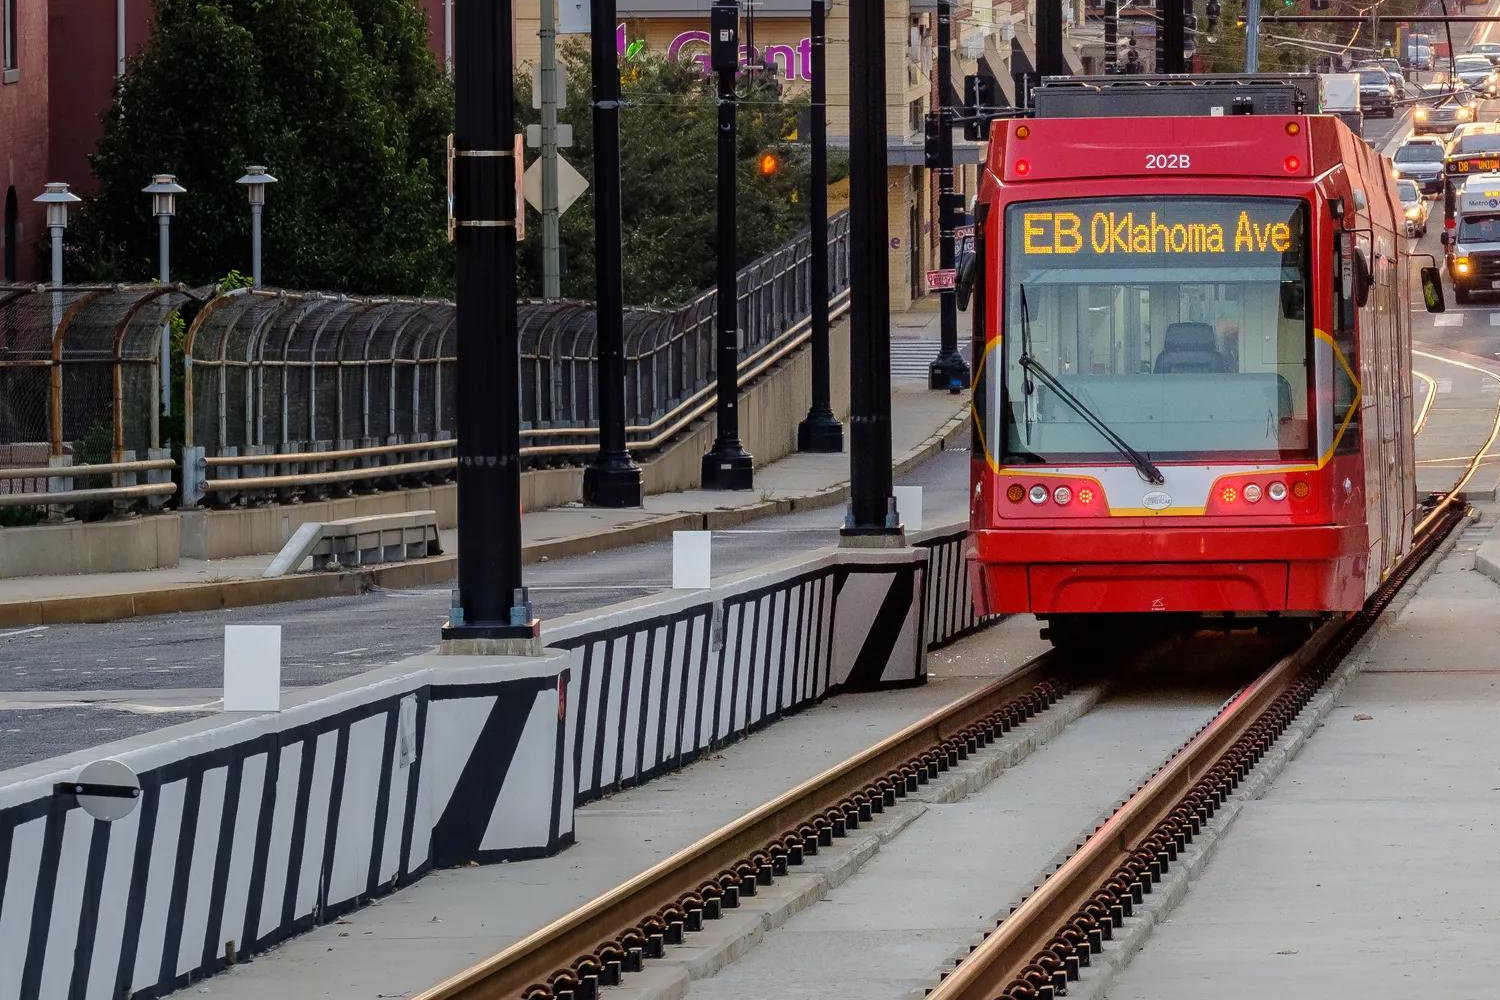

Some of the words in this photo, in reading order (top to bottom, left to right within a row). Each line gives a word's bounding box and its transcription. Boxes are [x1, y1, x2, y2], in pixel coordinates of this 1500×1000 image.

[1145, 154, 1191, 169] 202B
[1478, 159, 1500, 170] UNION
[1024, 212, 1083, 254] EB
[1235, 211, 1291, 254] Ave
